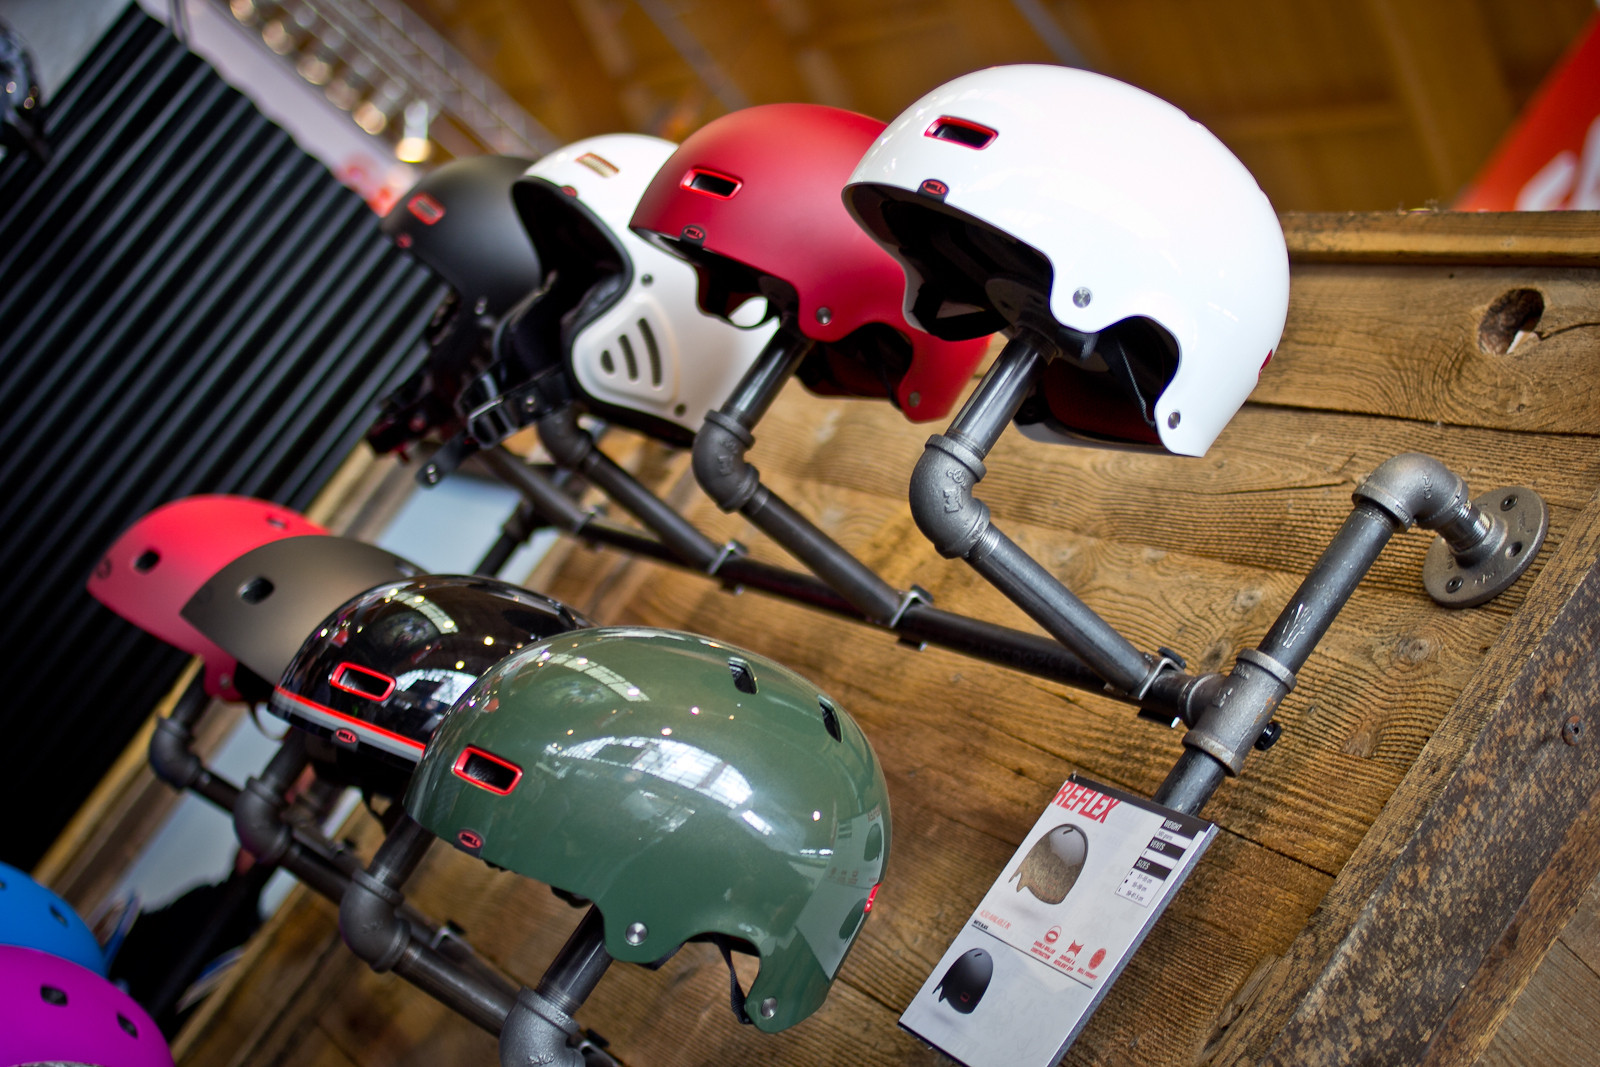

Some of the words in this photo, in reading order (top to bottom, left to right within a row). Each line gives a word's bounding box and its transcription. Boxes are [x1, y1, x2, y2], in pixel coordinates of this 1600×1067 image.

[1051, 781, 1121, 824] REFLEX
[1163, 819, 1183, 832] WEIGHT
[1149, 840, 1166, 851] VENTS
[1136, 859, 1151, 871] SIZES
